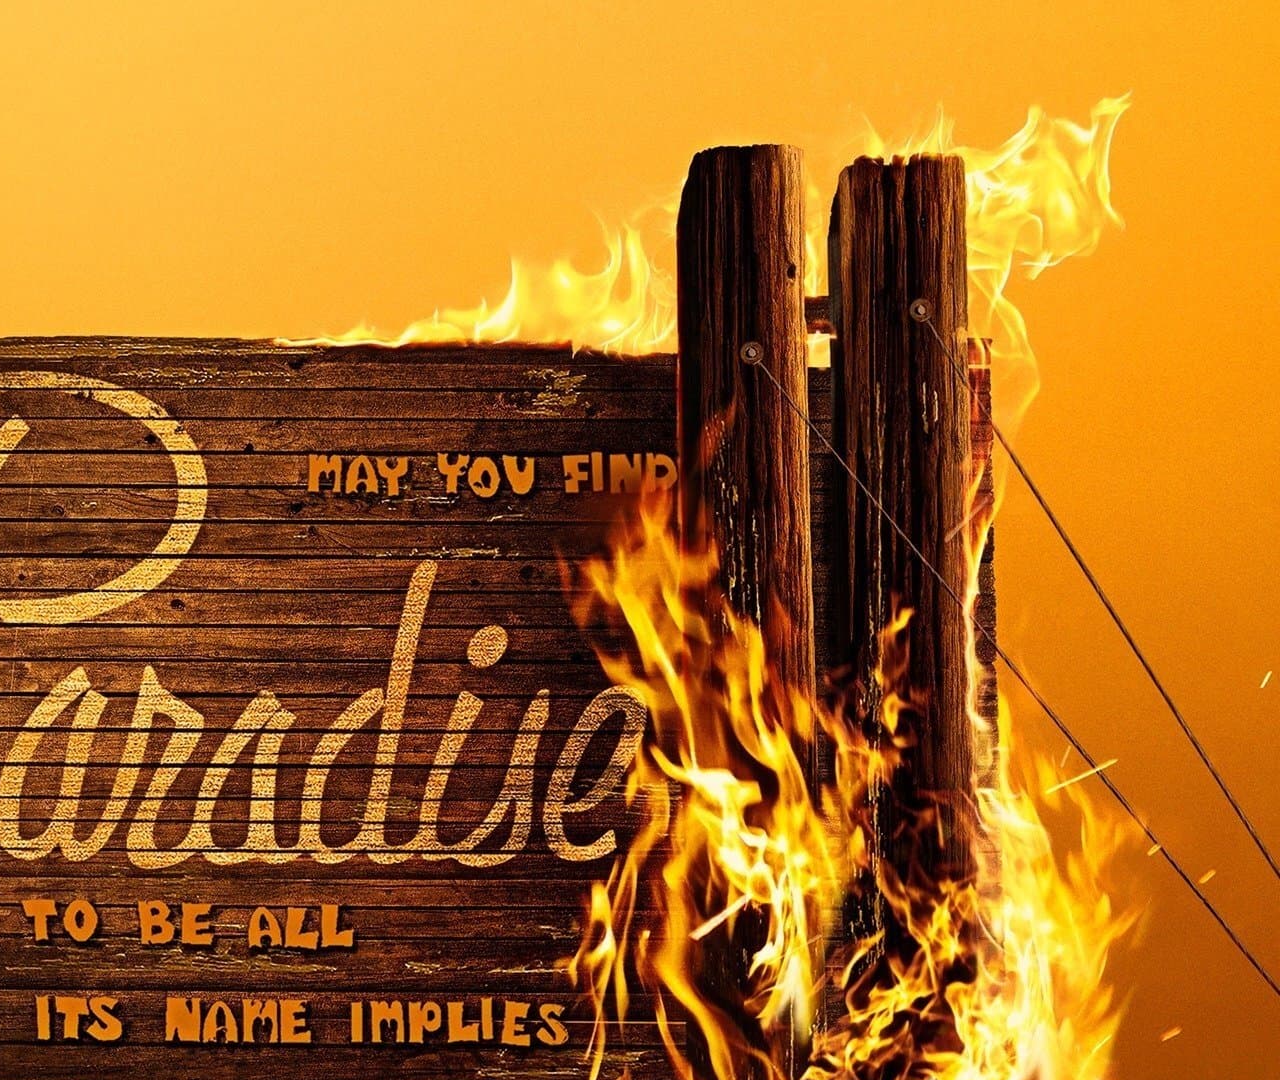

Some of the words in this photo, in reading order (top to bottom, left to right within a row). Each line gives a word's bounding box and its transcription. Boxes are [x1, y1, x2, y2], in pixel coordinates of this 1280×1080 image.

[307, 453, 408, 497] MAY
[437, 452, 535, 498] YOU
[562, 451, 679, 494] FIND
[22, 899, 99, 943] TO
[139, 899, 214, 946] BE
[248, 903, 354, 950] ALL
[35, 995, 124, 1042] ITS
[164, 996, 313, 1044] NAME
[350, 995, 570, 1047] IMPLIES
